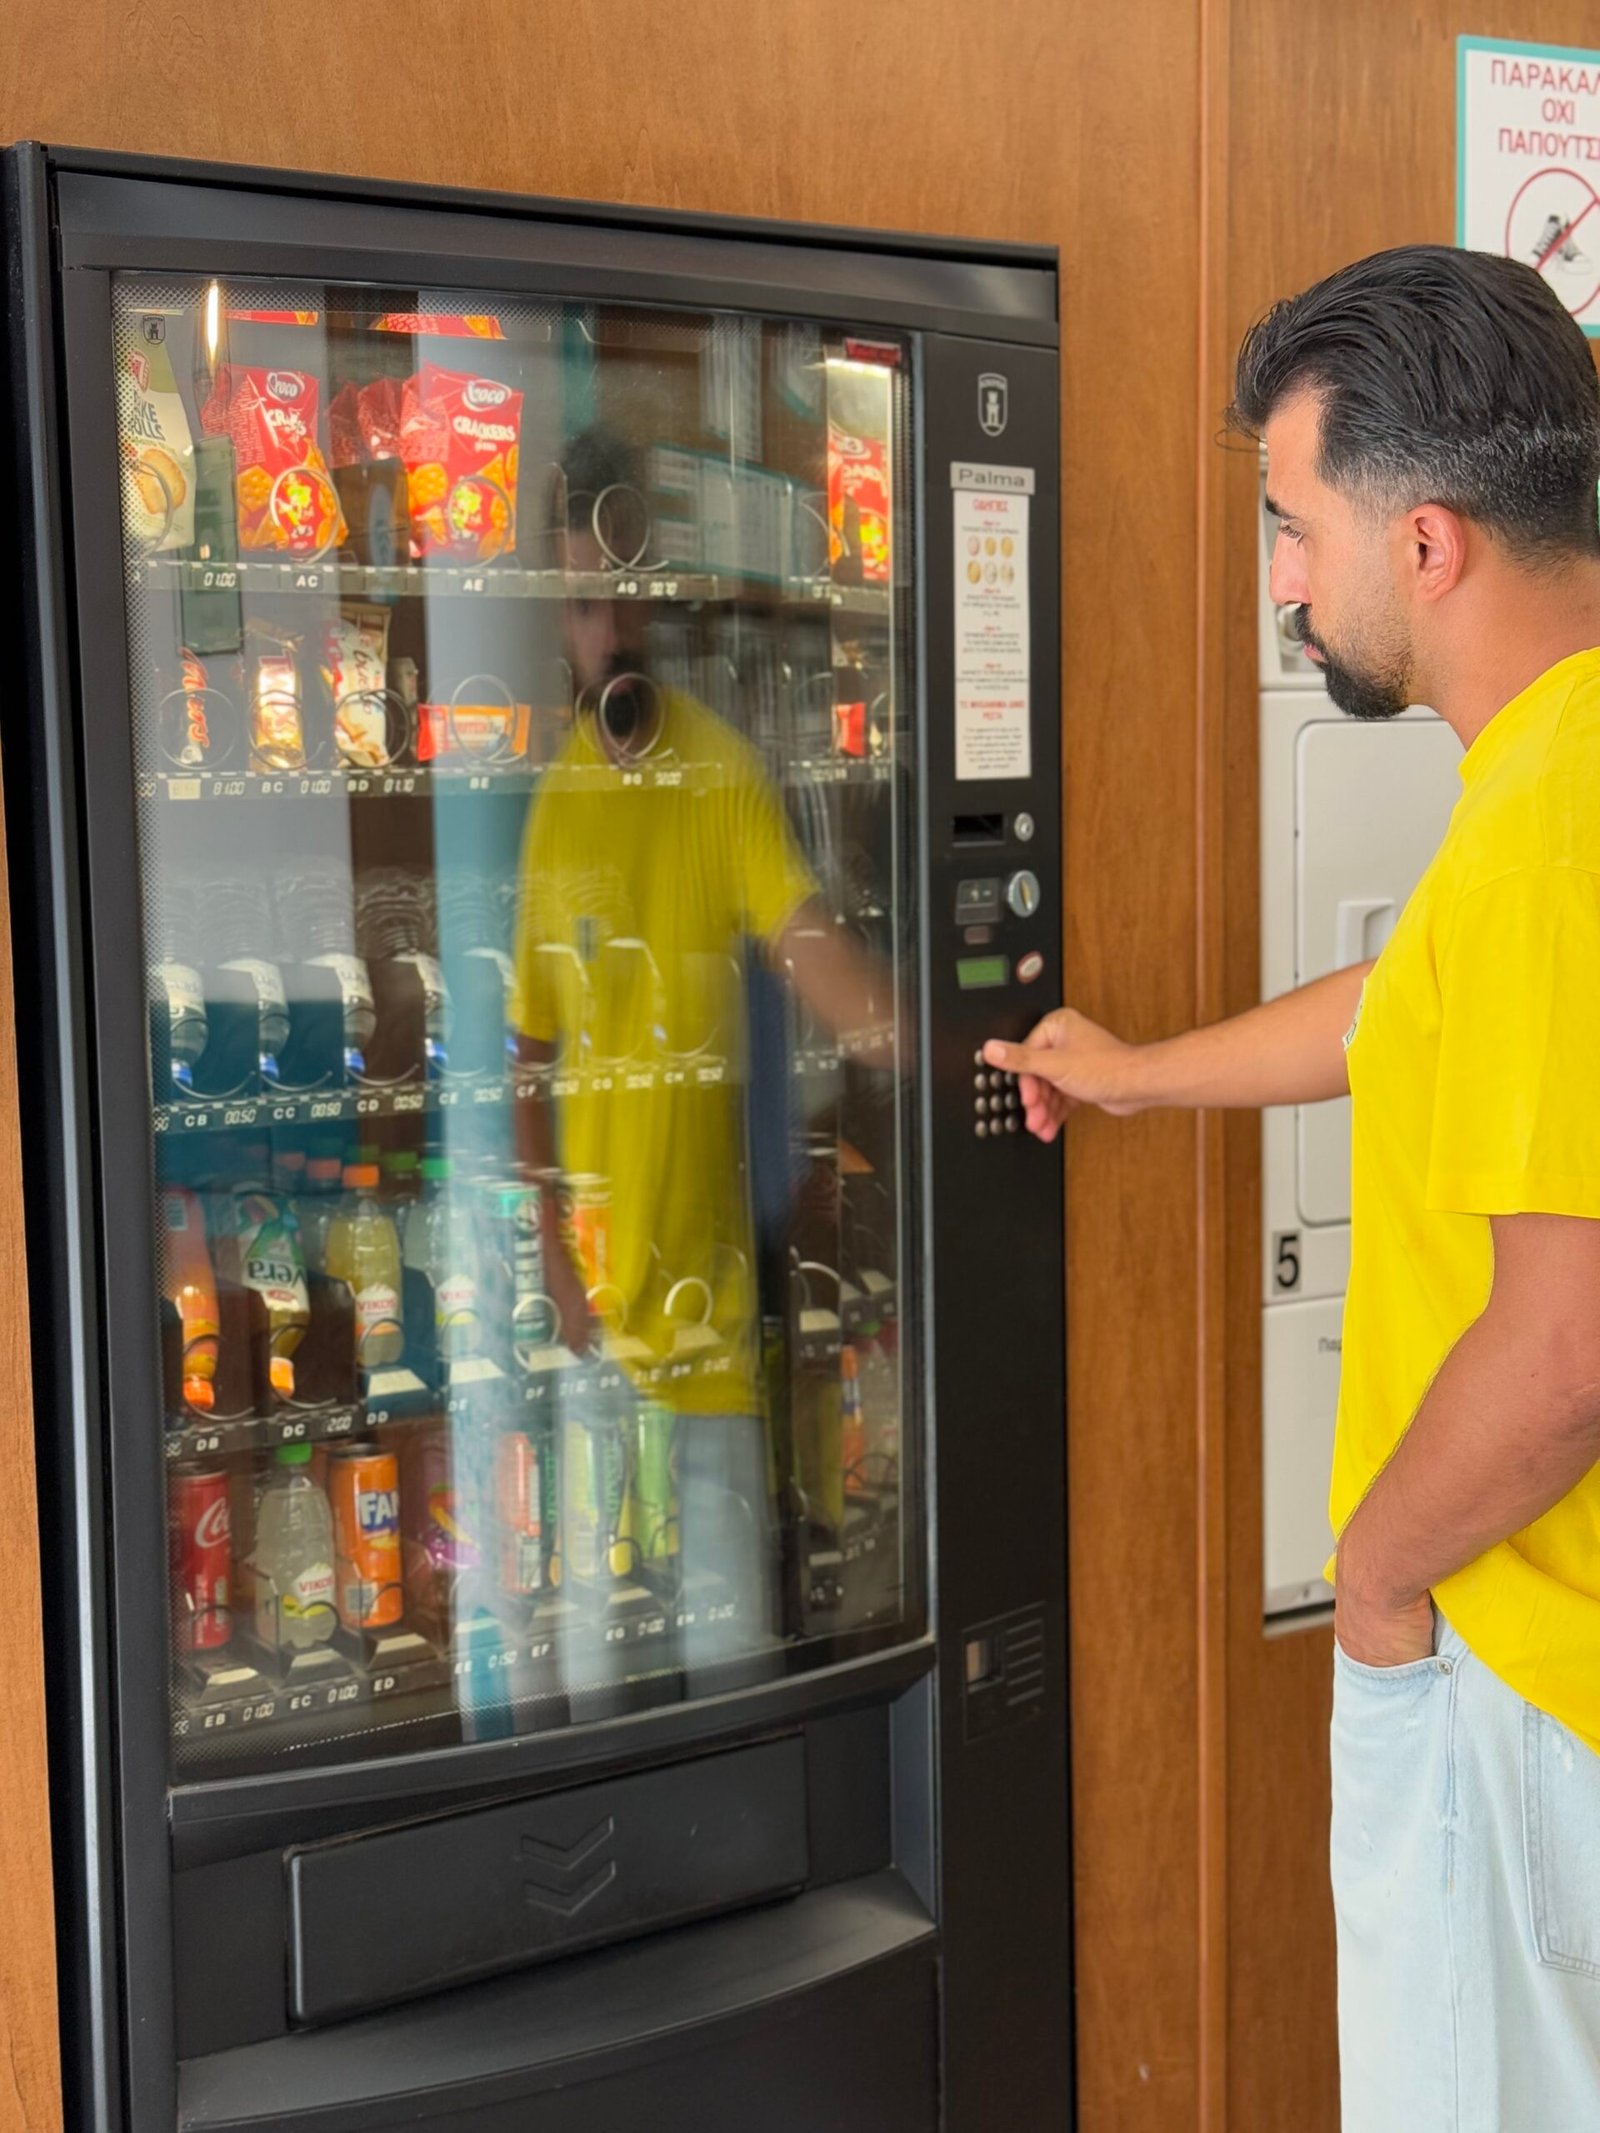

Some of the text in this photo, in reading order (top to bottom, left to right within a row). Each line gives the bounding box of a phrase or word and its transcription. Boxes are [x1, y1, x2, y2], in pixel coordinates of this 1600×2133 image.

[1542, 97, 1575, 125] ΟΧΙ
[453, 416, 516, 442] CRACKERS
[959, 467, 1026, 487] Palma
[1277, 1235, 1299, 1288] 5
